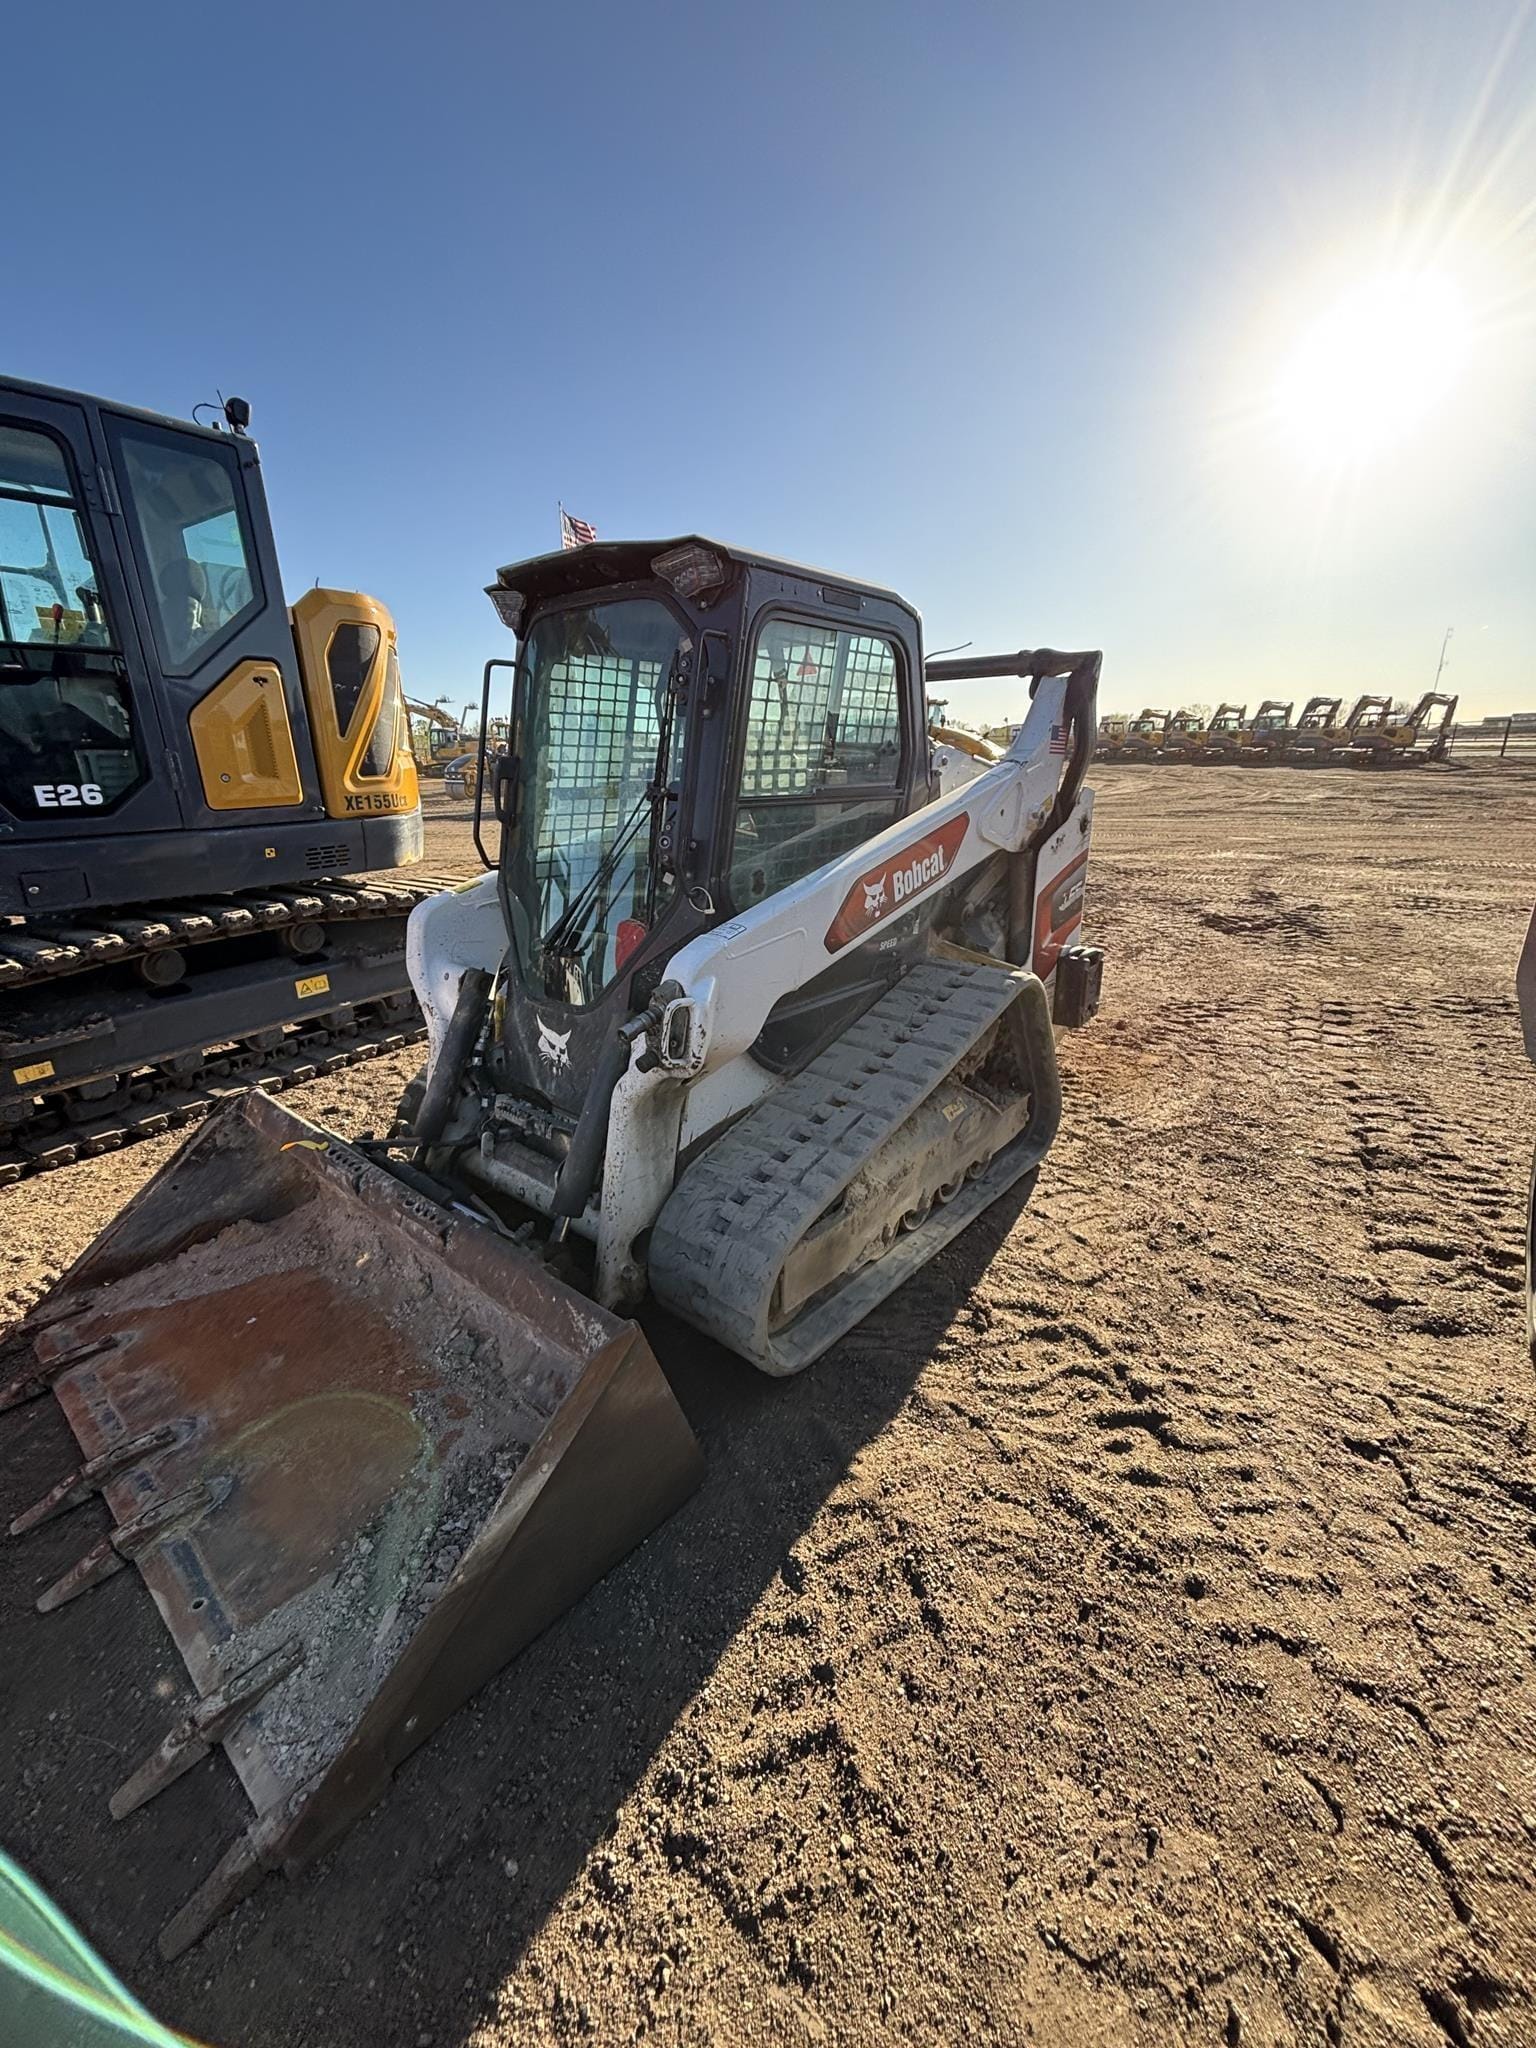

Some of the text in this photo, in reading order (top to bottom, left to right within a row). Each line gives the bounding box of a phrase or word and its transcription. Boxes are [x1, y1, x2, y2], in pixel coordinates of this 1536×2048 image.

[33, 784, 103, 807] E26
[893, 844, 945, 902] Bobcat
[880, 937, 898, 951] SPEED
